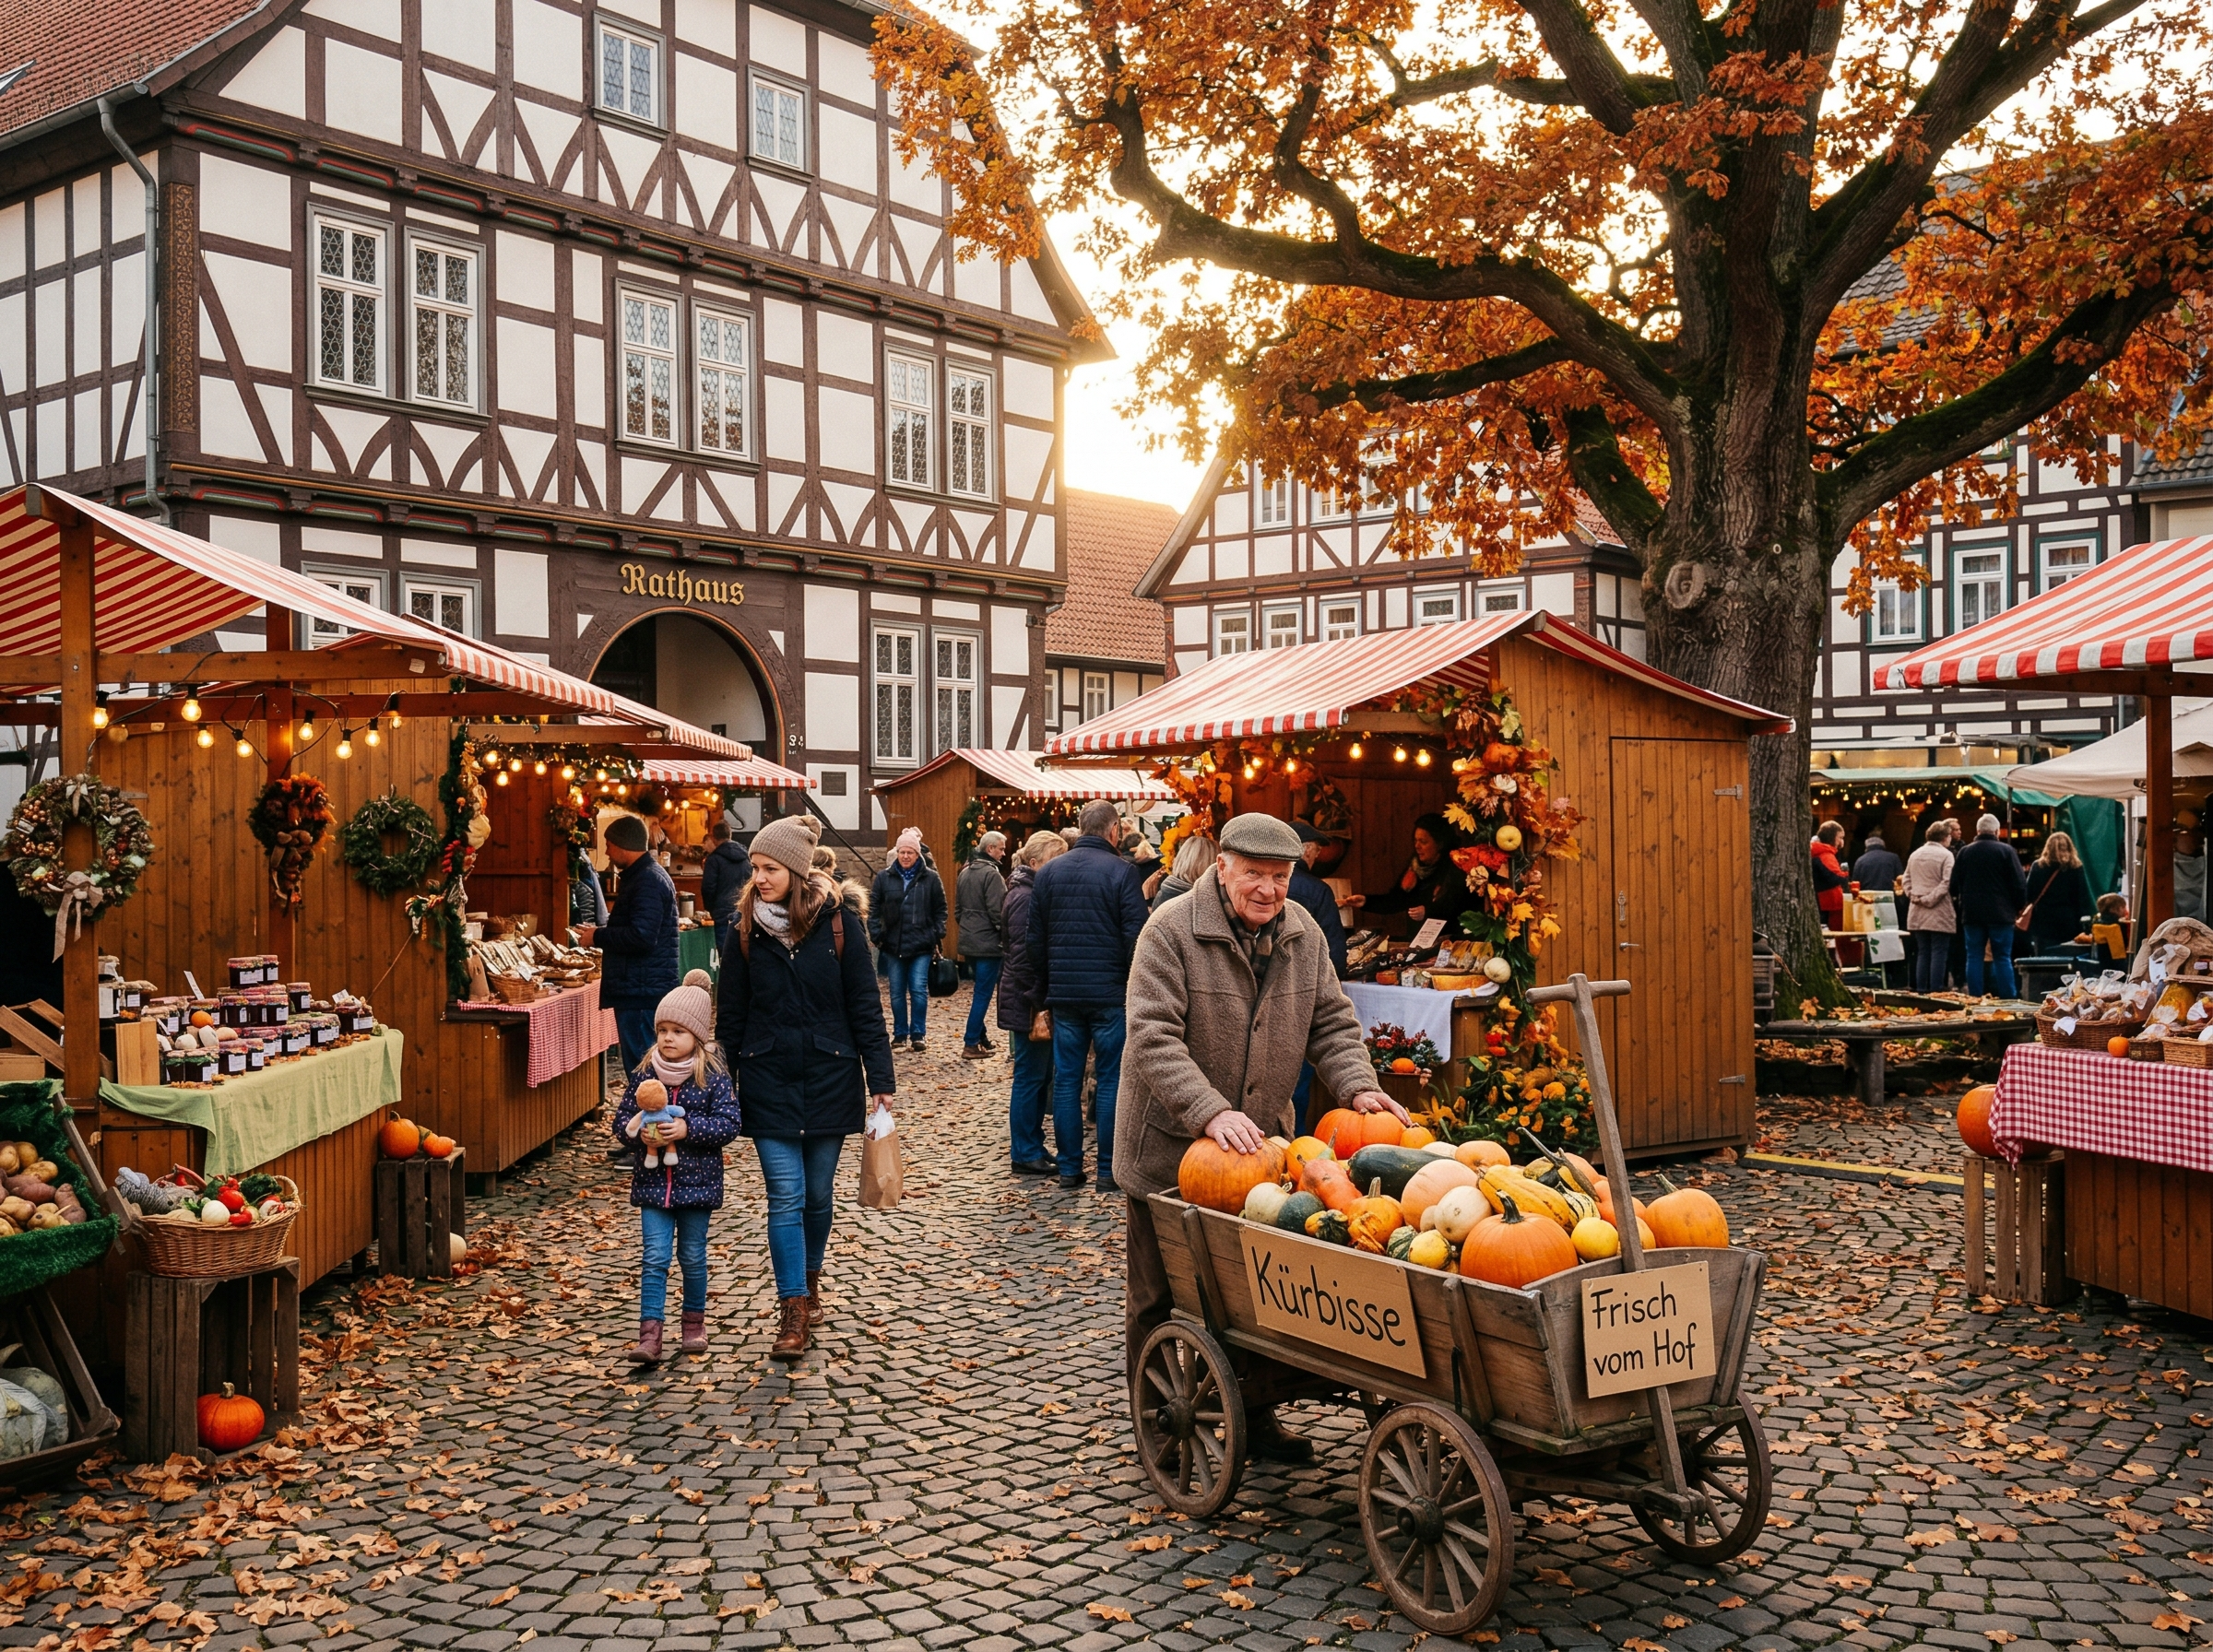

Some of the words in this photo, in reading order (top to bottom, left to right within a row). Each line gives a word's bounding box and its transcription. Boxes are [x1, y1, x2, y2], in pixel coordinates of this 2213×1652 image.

[621, 562, 745, 606] Rathaus
[1251, 1245, 1406, 1347] Kürbisse
[1591, 1280, 1676, 1329] Frisch
[1592, 1349, 1644, 1376] vom
[1653, 1322, 1698, 1371] Hof
